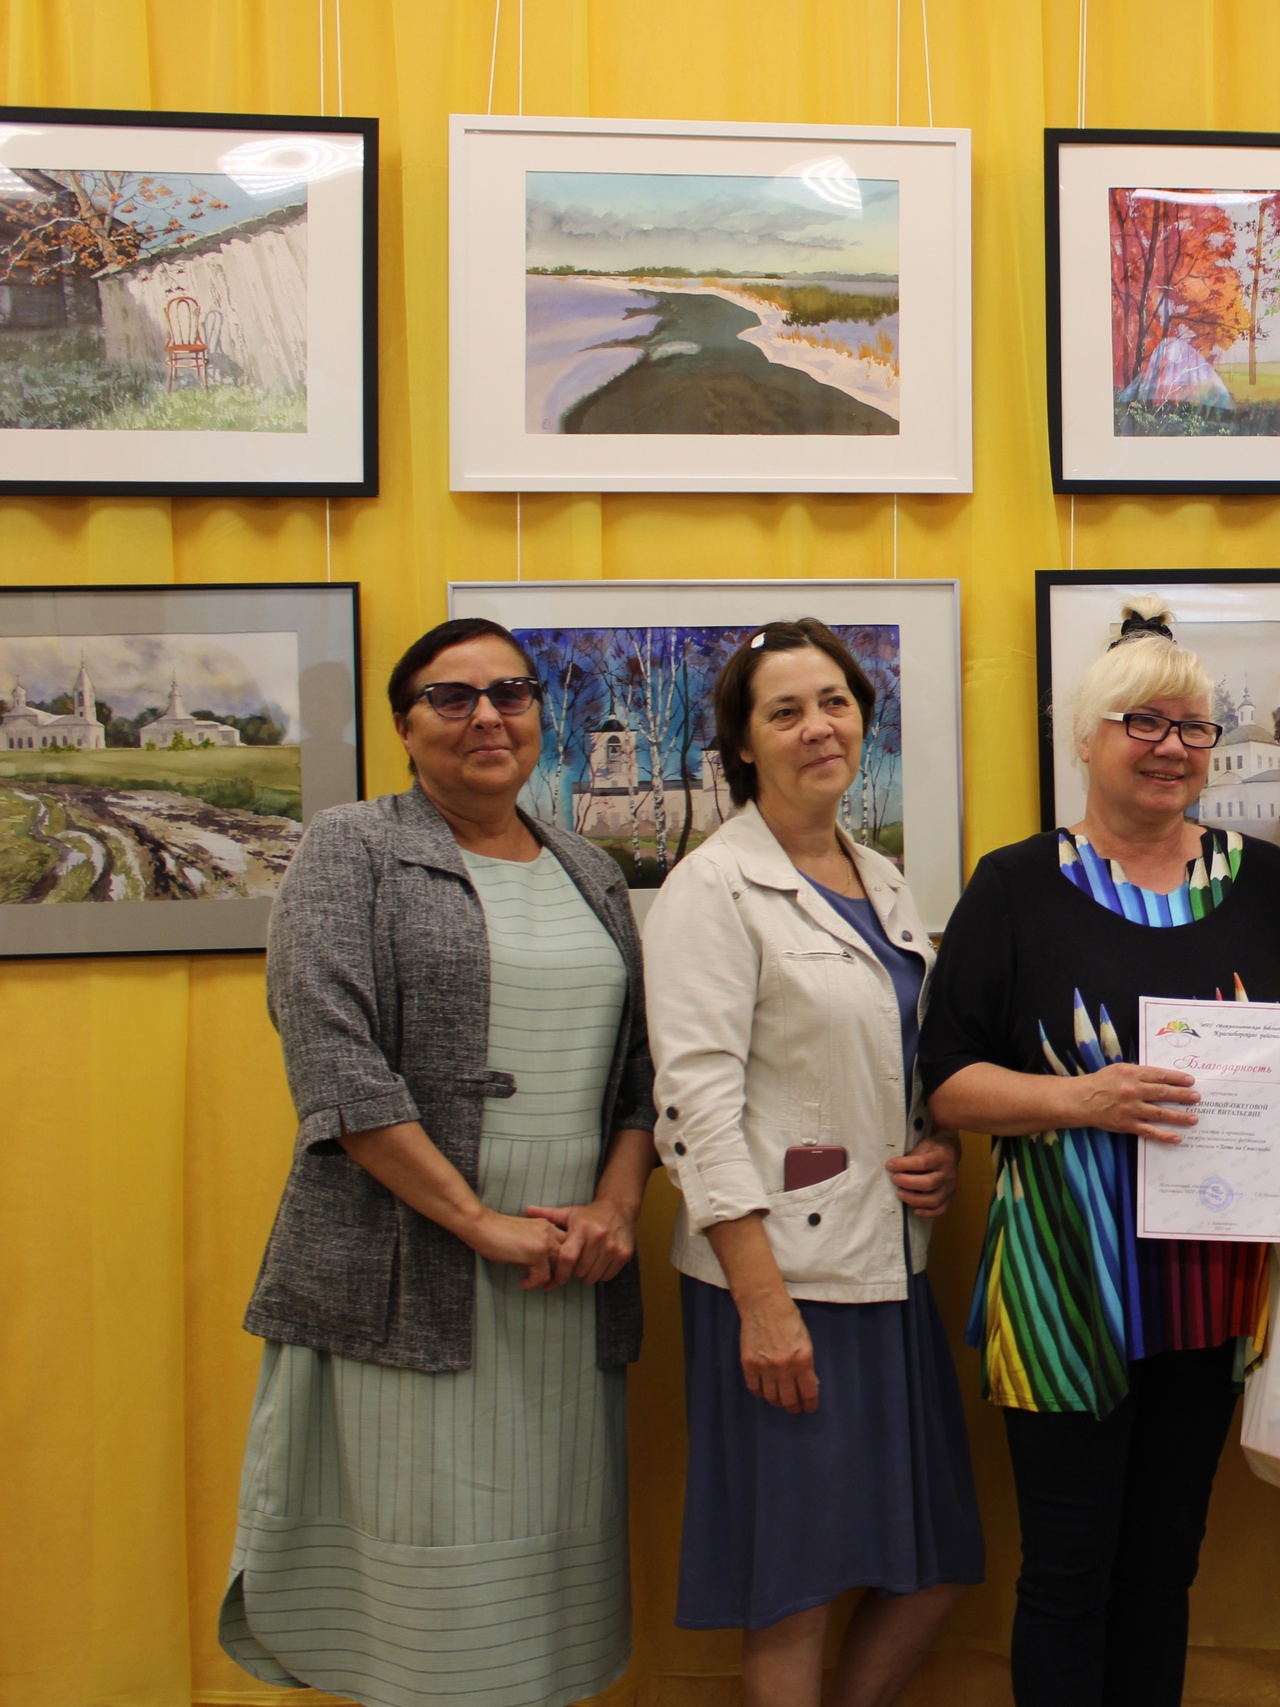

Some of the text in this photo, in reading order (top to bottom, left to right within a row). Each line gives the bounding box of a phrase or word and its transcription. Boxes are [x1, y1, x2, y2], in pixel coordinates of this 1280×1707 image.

[1173, 1054, 1272, 1076] Благодарность
[1185, 1107, 1262, 1117] ТАТЬЯНЕ ВИТАЛЬЕВНЕ
